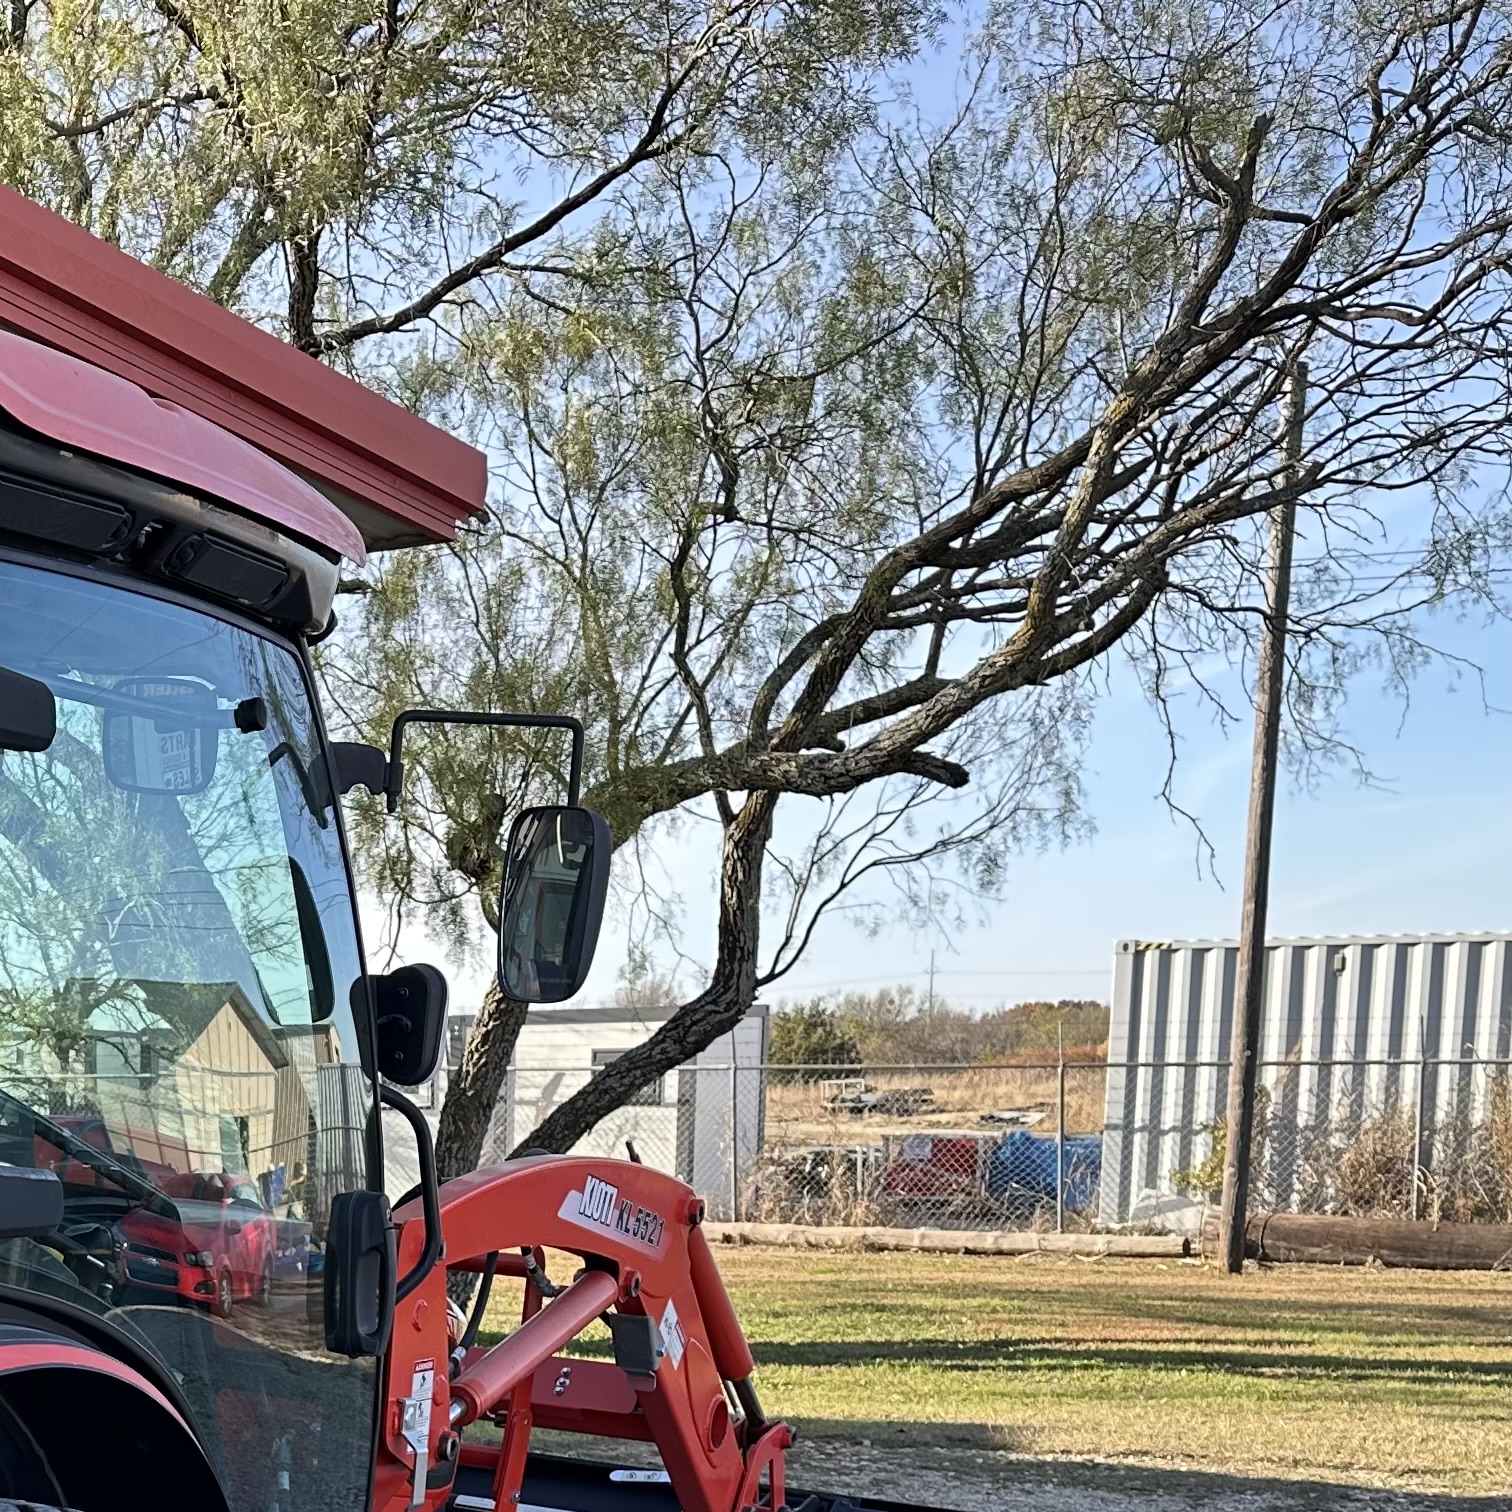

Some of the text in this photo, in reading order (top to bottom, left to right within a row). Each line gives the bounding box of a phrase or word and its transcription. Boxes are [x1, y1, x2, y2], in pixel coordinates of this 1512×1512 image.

[578, 1173, 665, 1248] KIOTI KL 5521
